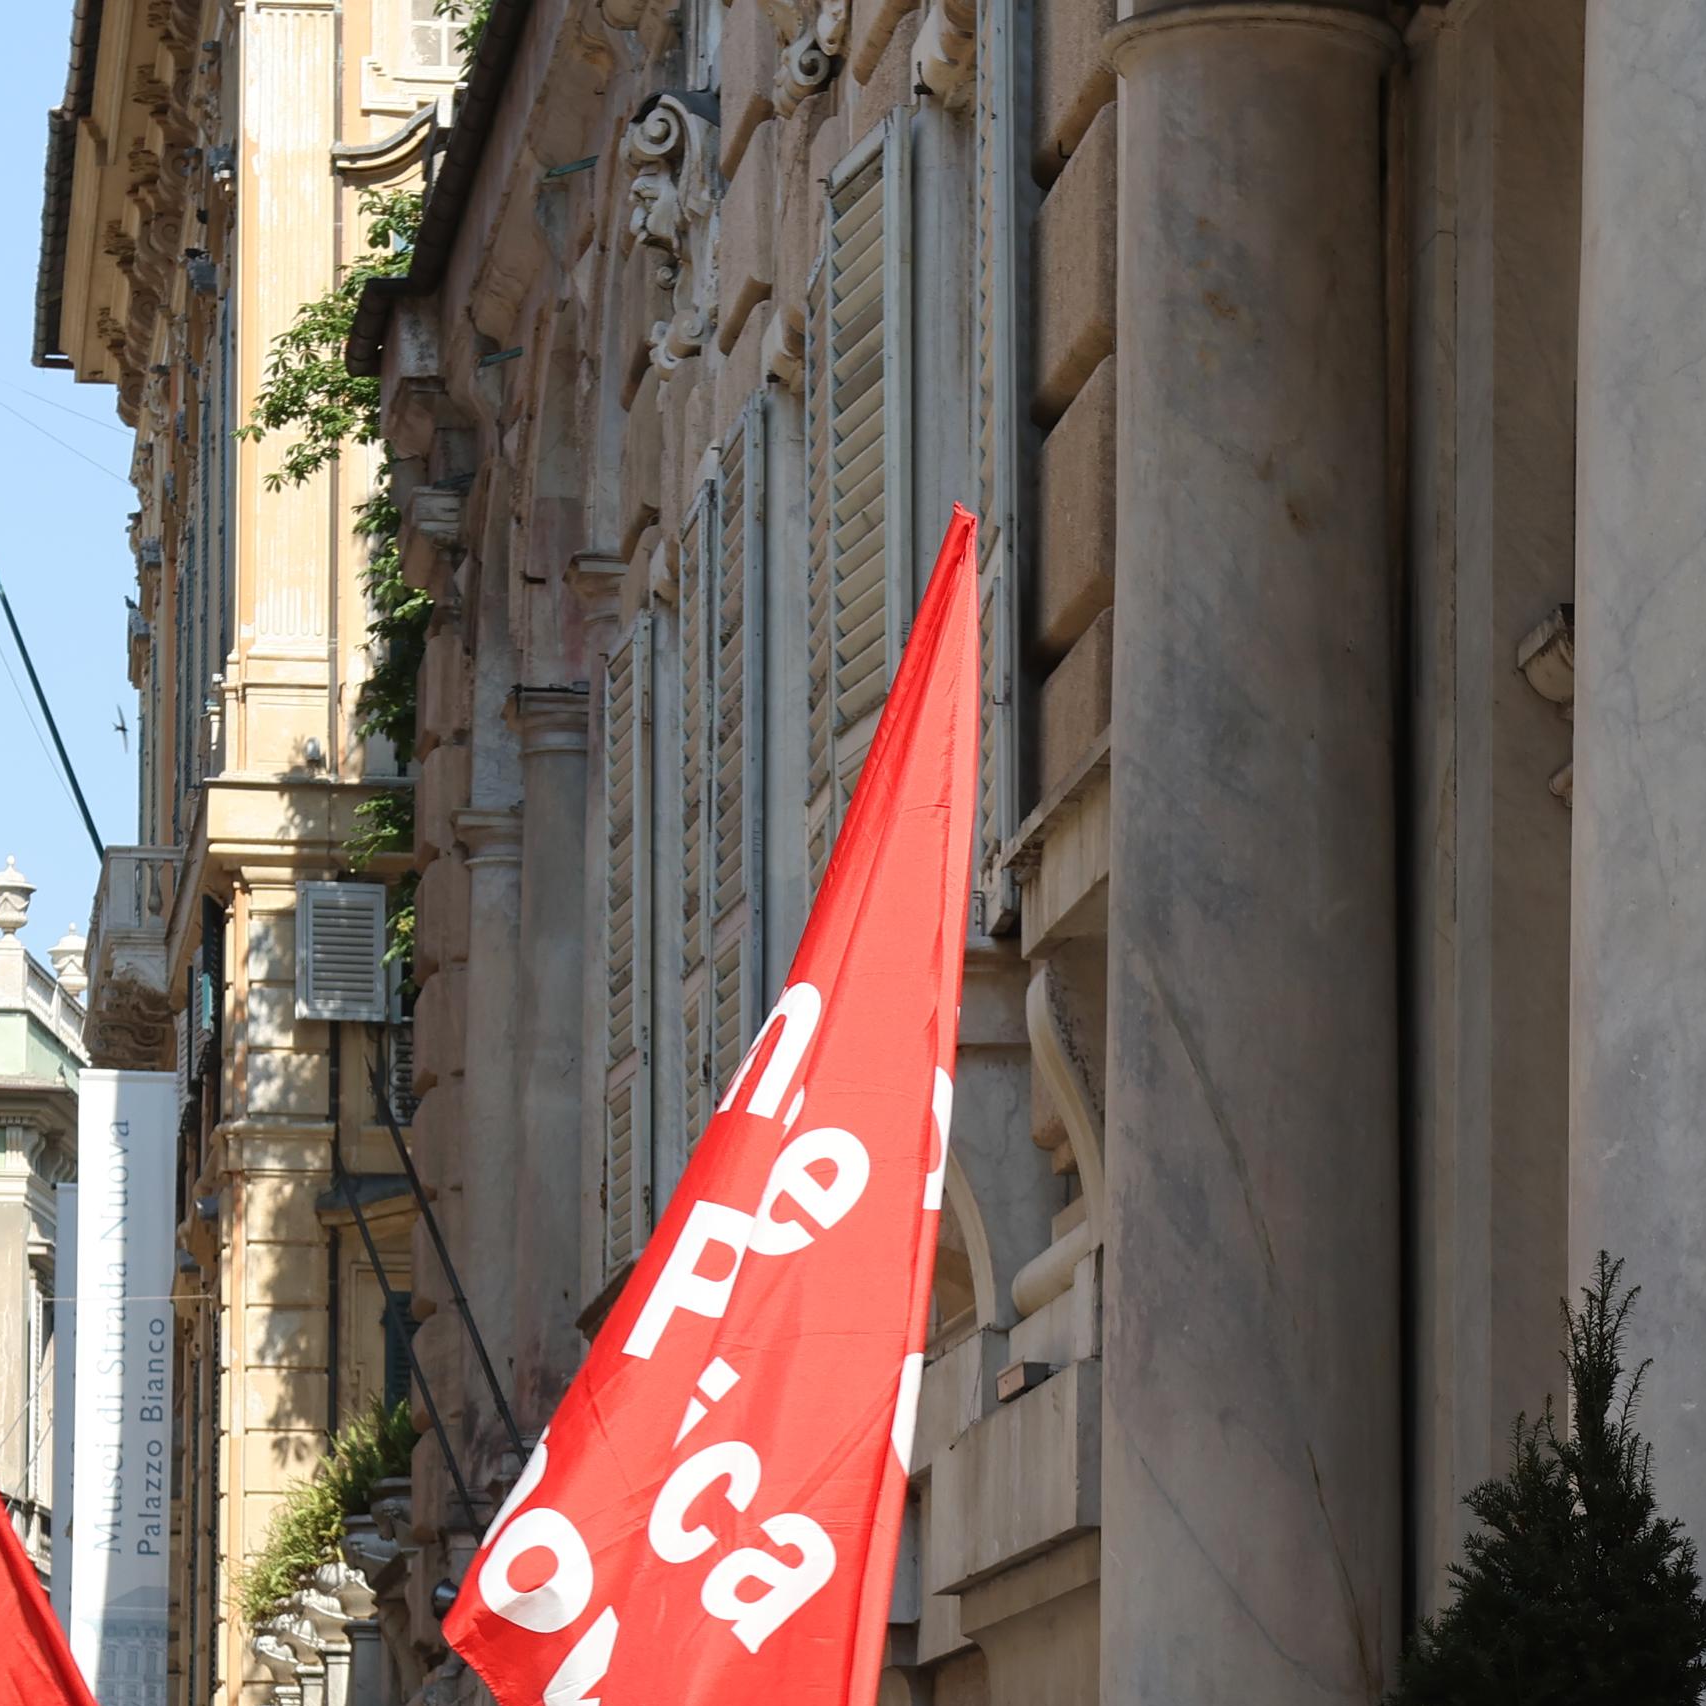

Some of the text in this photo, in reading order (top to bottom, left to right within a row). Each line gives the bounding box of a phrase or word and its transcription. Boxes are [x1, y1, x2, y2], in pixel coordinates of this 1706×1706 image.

[93, 1119, 130, 1554] Musei di Strada Nuova
[136, 1318, 165, 1556] Palazzo Bianco
